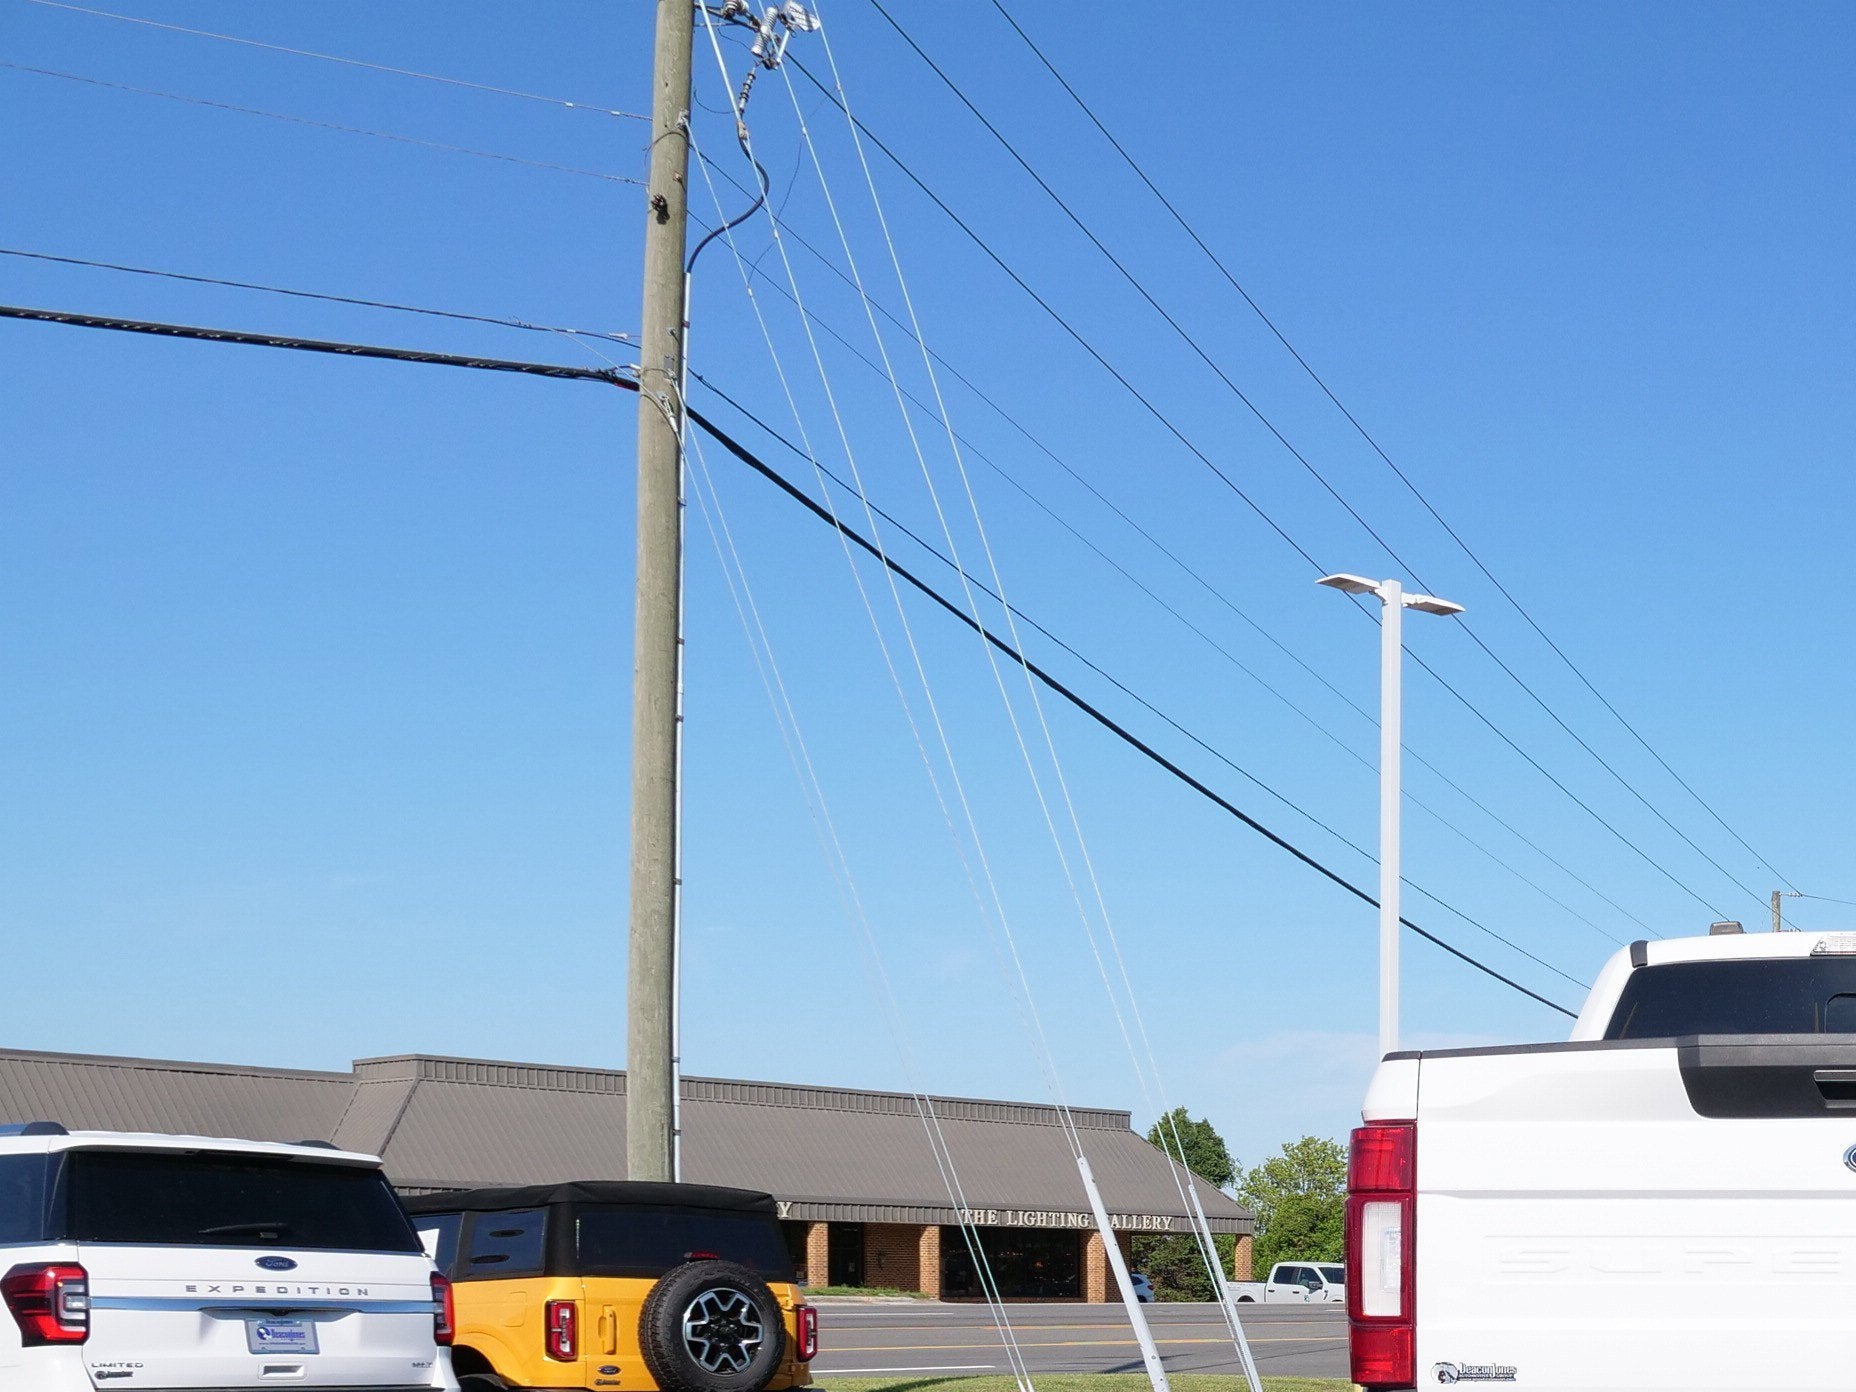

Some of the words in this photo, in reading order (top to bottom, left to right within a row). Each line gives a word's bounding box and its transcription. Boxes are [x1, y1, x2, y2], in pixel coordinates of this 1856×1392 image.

[961, 1209, 998, 1225] THE
[1006, 1210, 1090, 1228] LIGHTING
[1110, 1214, 1173, 1230] ALLERY
[185, 1284, 369, 1296] EXPEDITION
